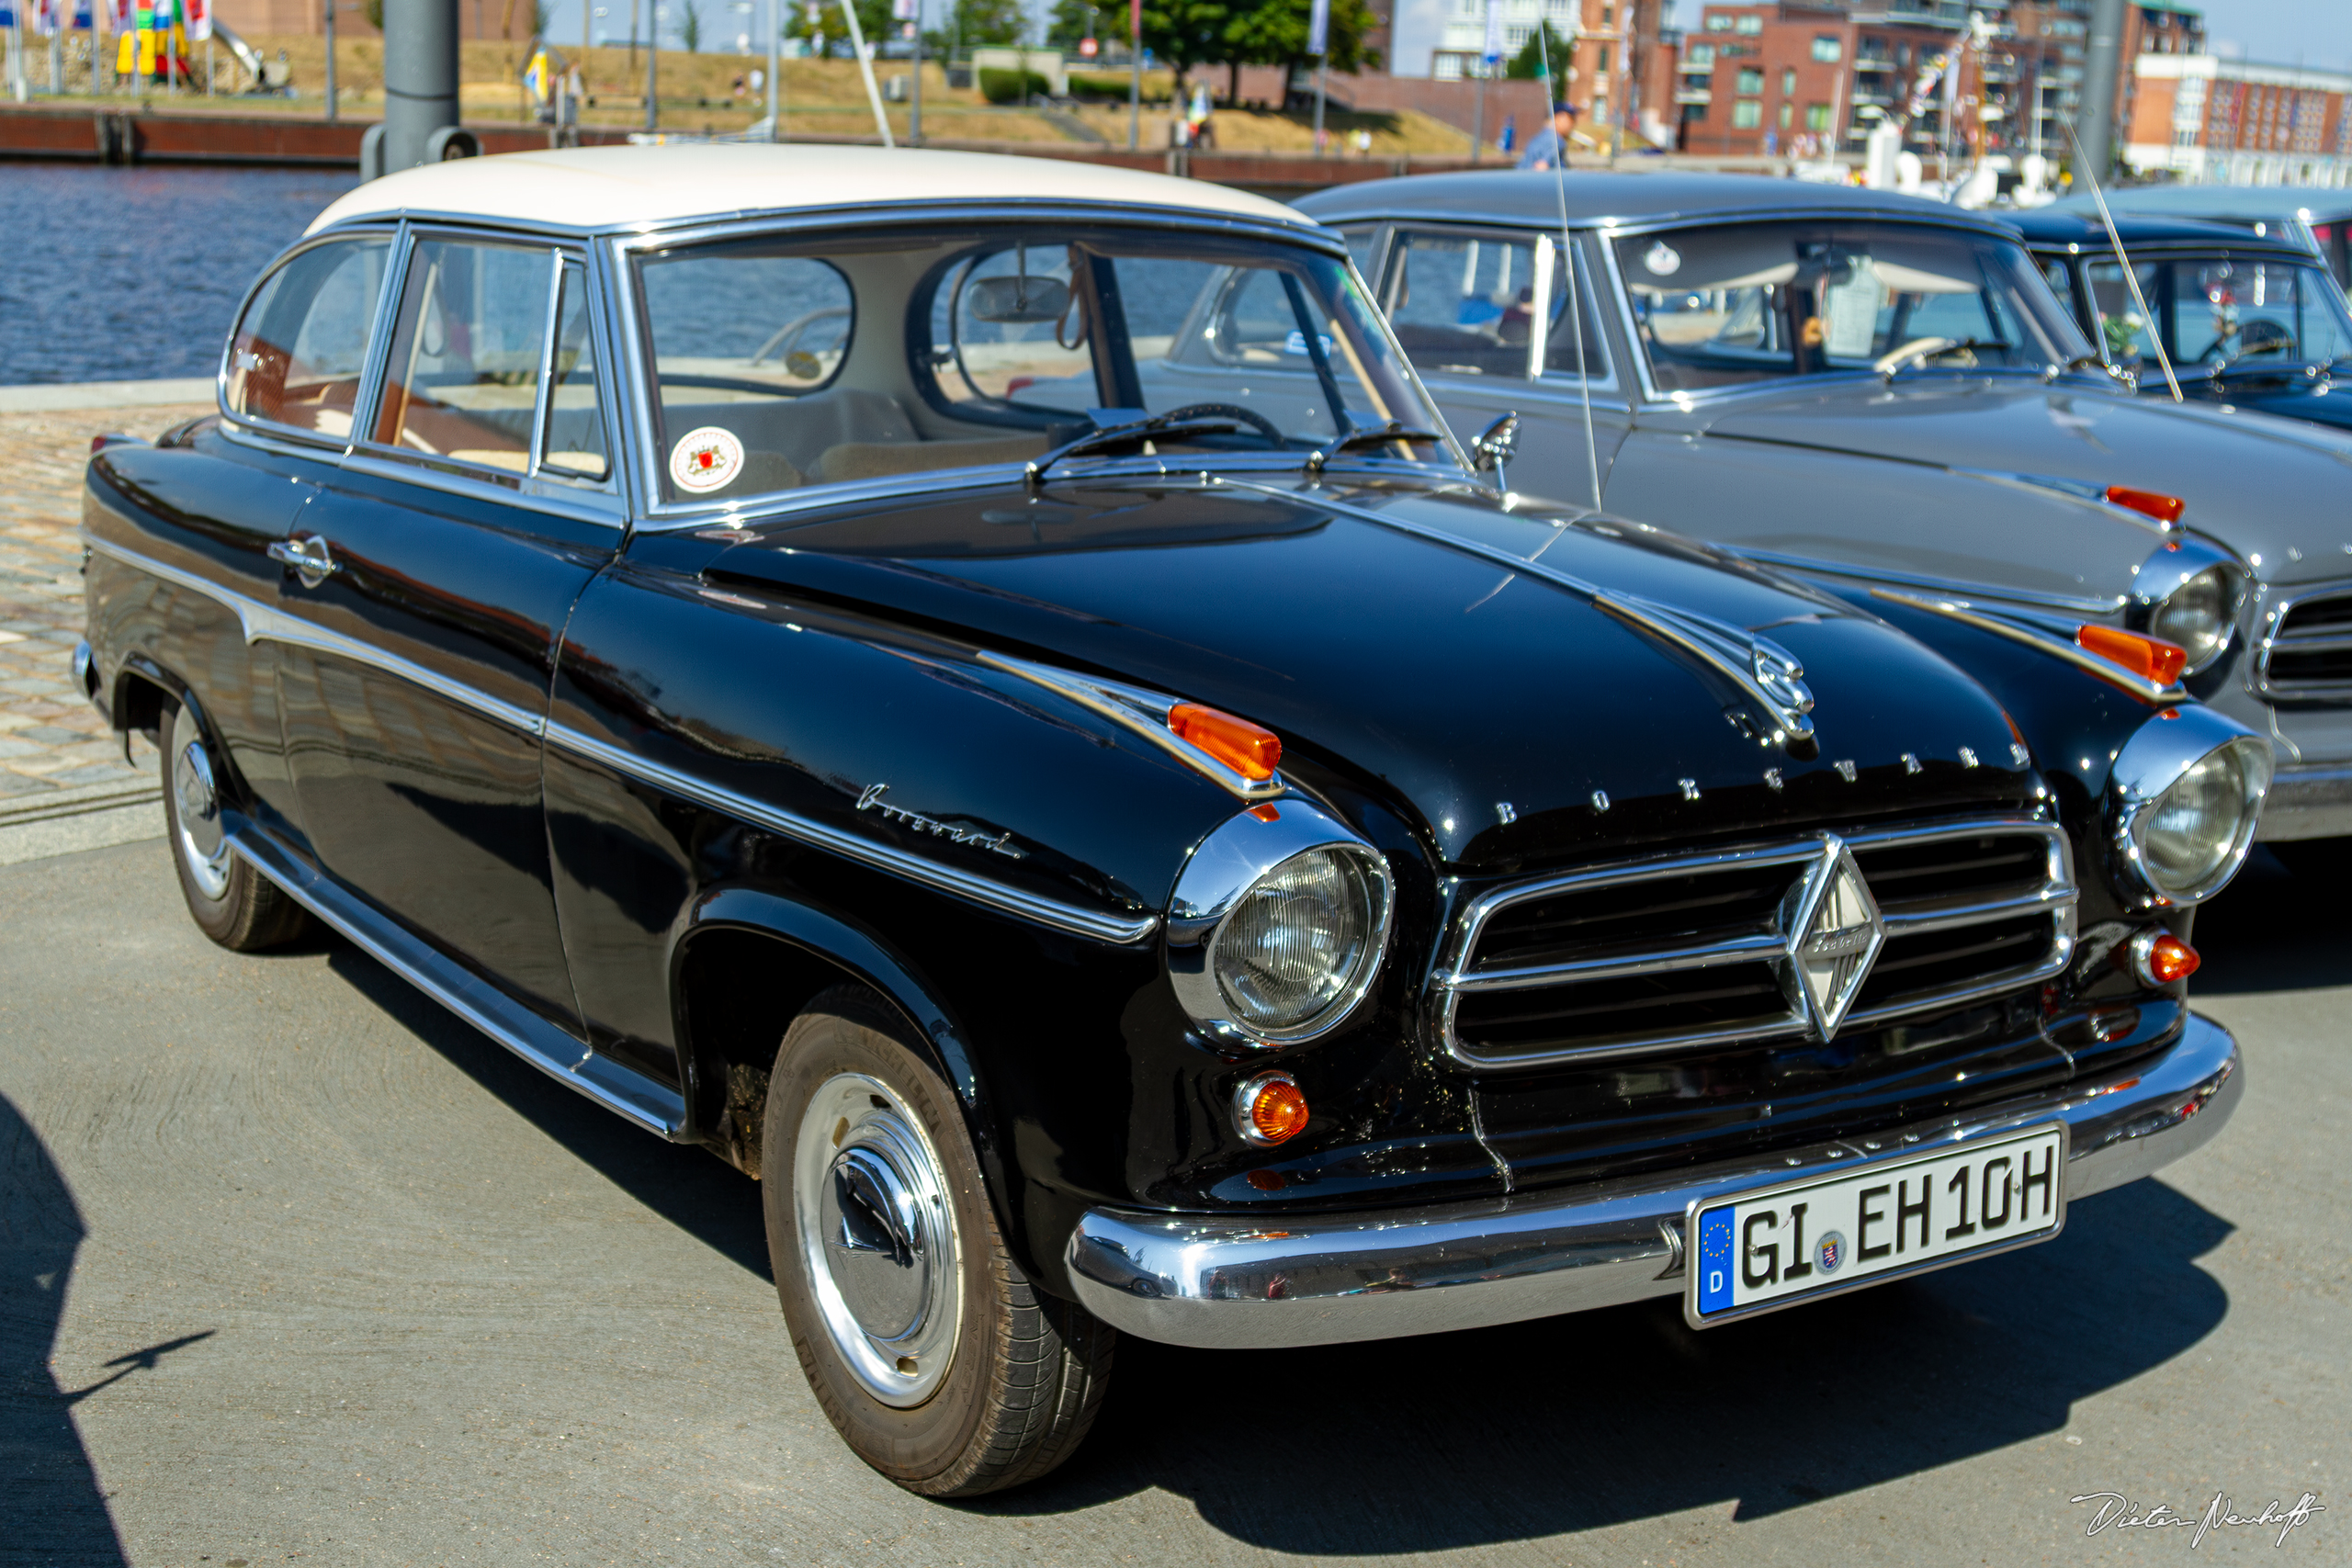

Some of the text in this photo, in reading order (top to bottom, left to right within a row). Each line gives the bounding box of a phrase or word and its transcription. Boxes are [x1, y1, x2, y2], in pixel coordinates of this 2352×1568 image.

[855, 783, 1021, 859] Borgward
[1709, 1269, 1724, 1294] D
[1742, 1201, 1813, 1290] GI
